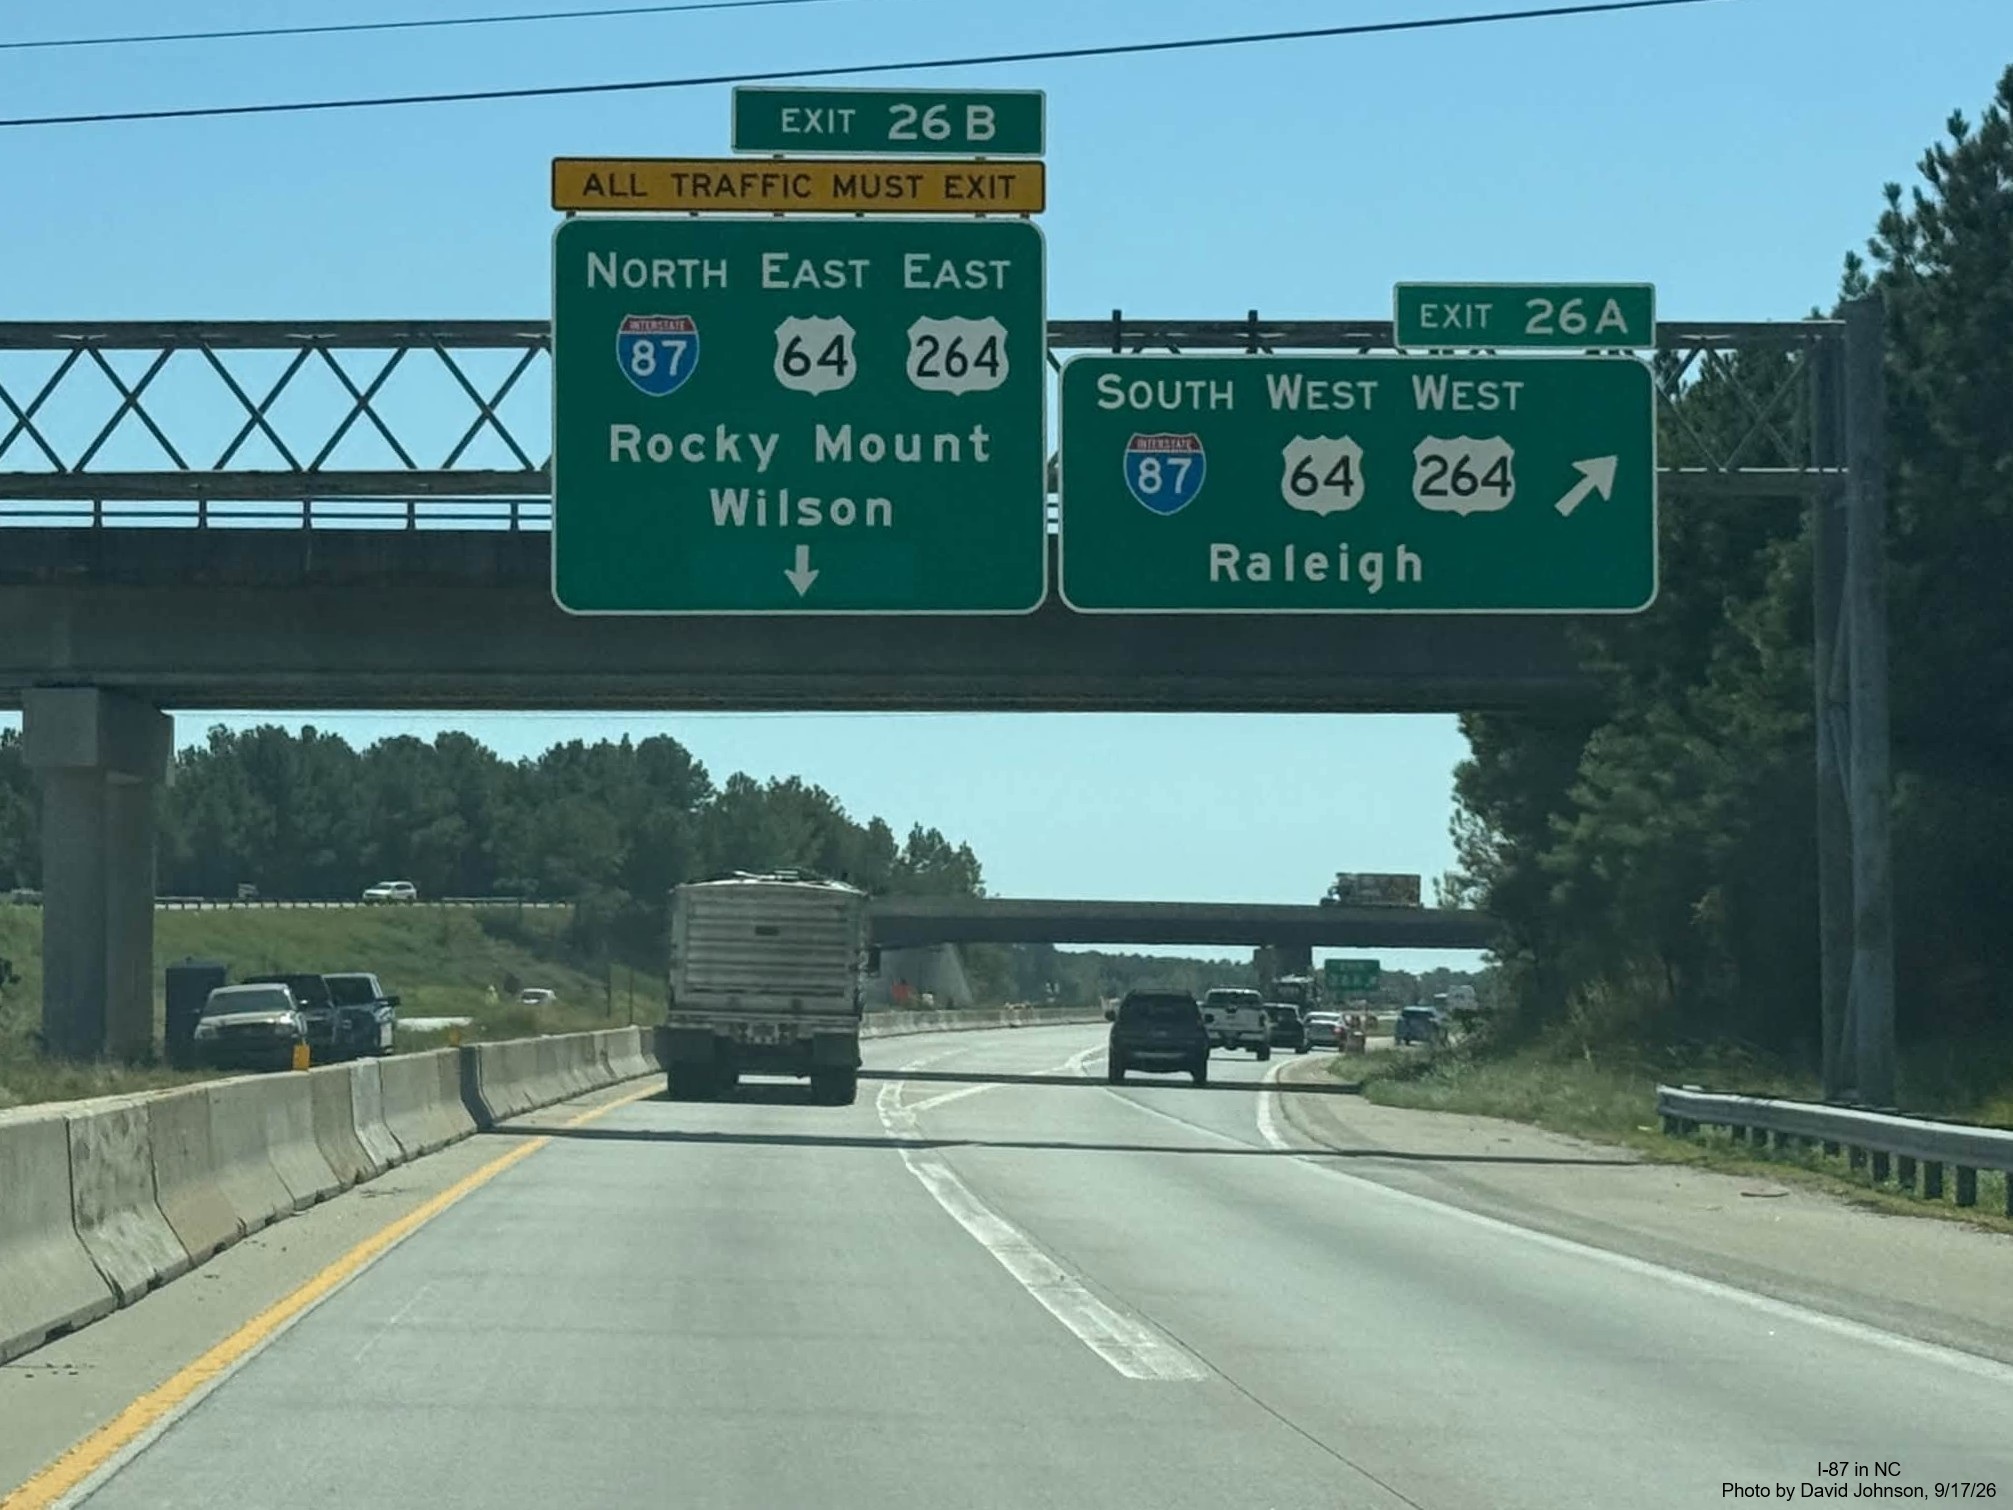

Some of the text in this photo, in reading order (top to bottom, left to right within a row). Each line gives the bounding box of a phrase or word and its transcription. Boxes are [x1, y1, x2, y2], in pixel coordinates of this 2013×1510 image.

[781, 108, 856, 134] EXIT
[583, 173, 1016, 200] ALL TRAFFIC MUST EXIT
[1420, 304, 1493, 330] EXIT
[630, 340, 687, 377] 87
[781, 334, 849, 377] 64
[915, 335, 1000, 378] 264
[610, 424, 991, 473] Rocky Mount
[1137, 457, 1193, 495] 87
[1289, 454, 1355, 497] 64
[1419, 454, 1511, 497] 264
[709, 488, 893, 527] Wilson
[1210, 543, 1423, 595] Raleigh
